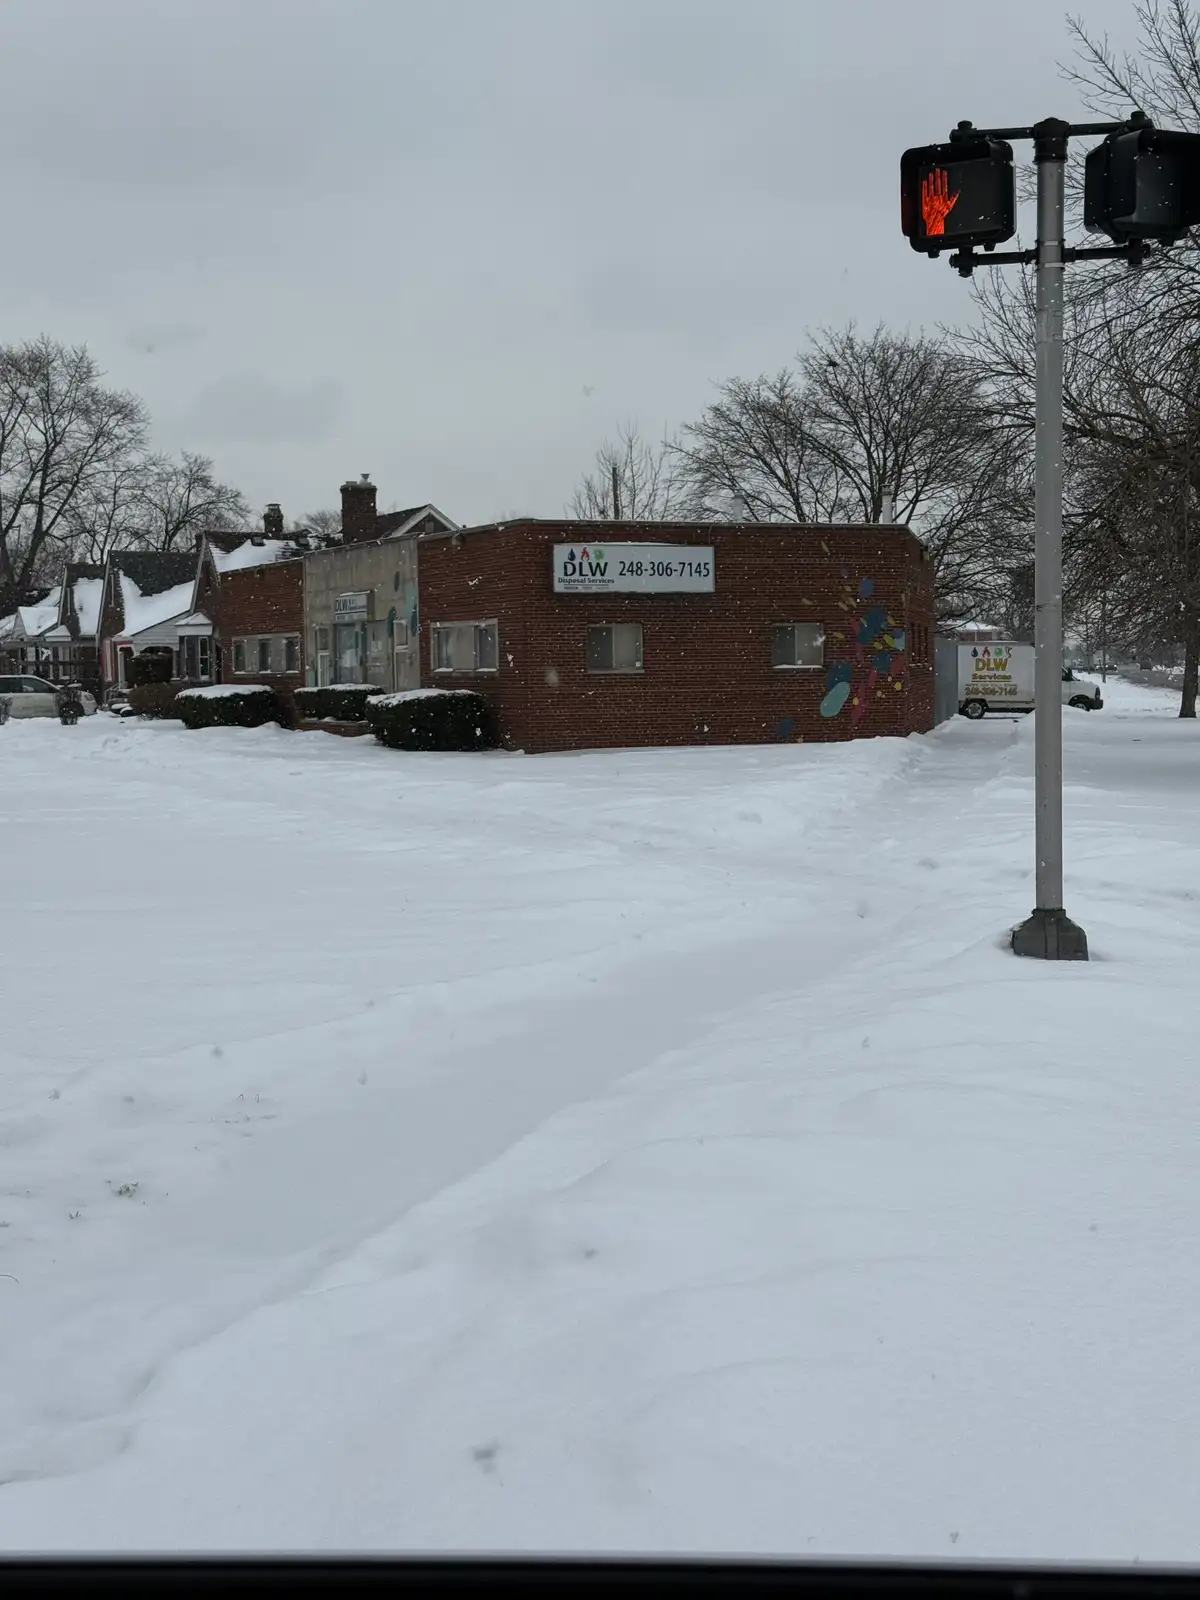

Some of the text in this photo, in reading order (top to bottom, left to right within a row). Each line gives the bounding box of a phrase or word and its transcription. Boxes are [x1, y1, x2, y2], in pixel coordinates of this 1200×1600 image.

[564, 561, 608, 576] DLW
[619, 561, 710, 577] 248-306-7145
[975, 658, 1008, 671] DLW
